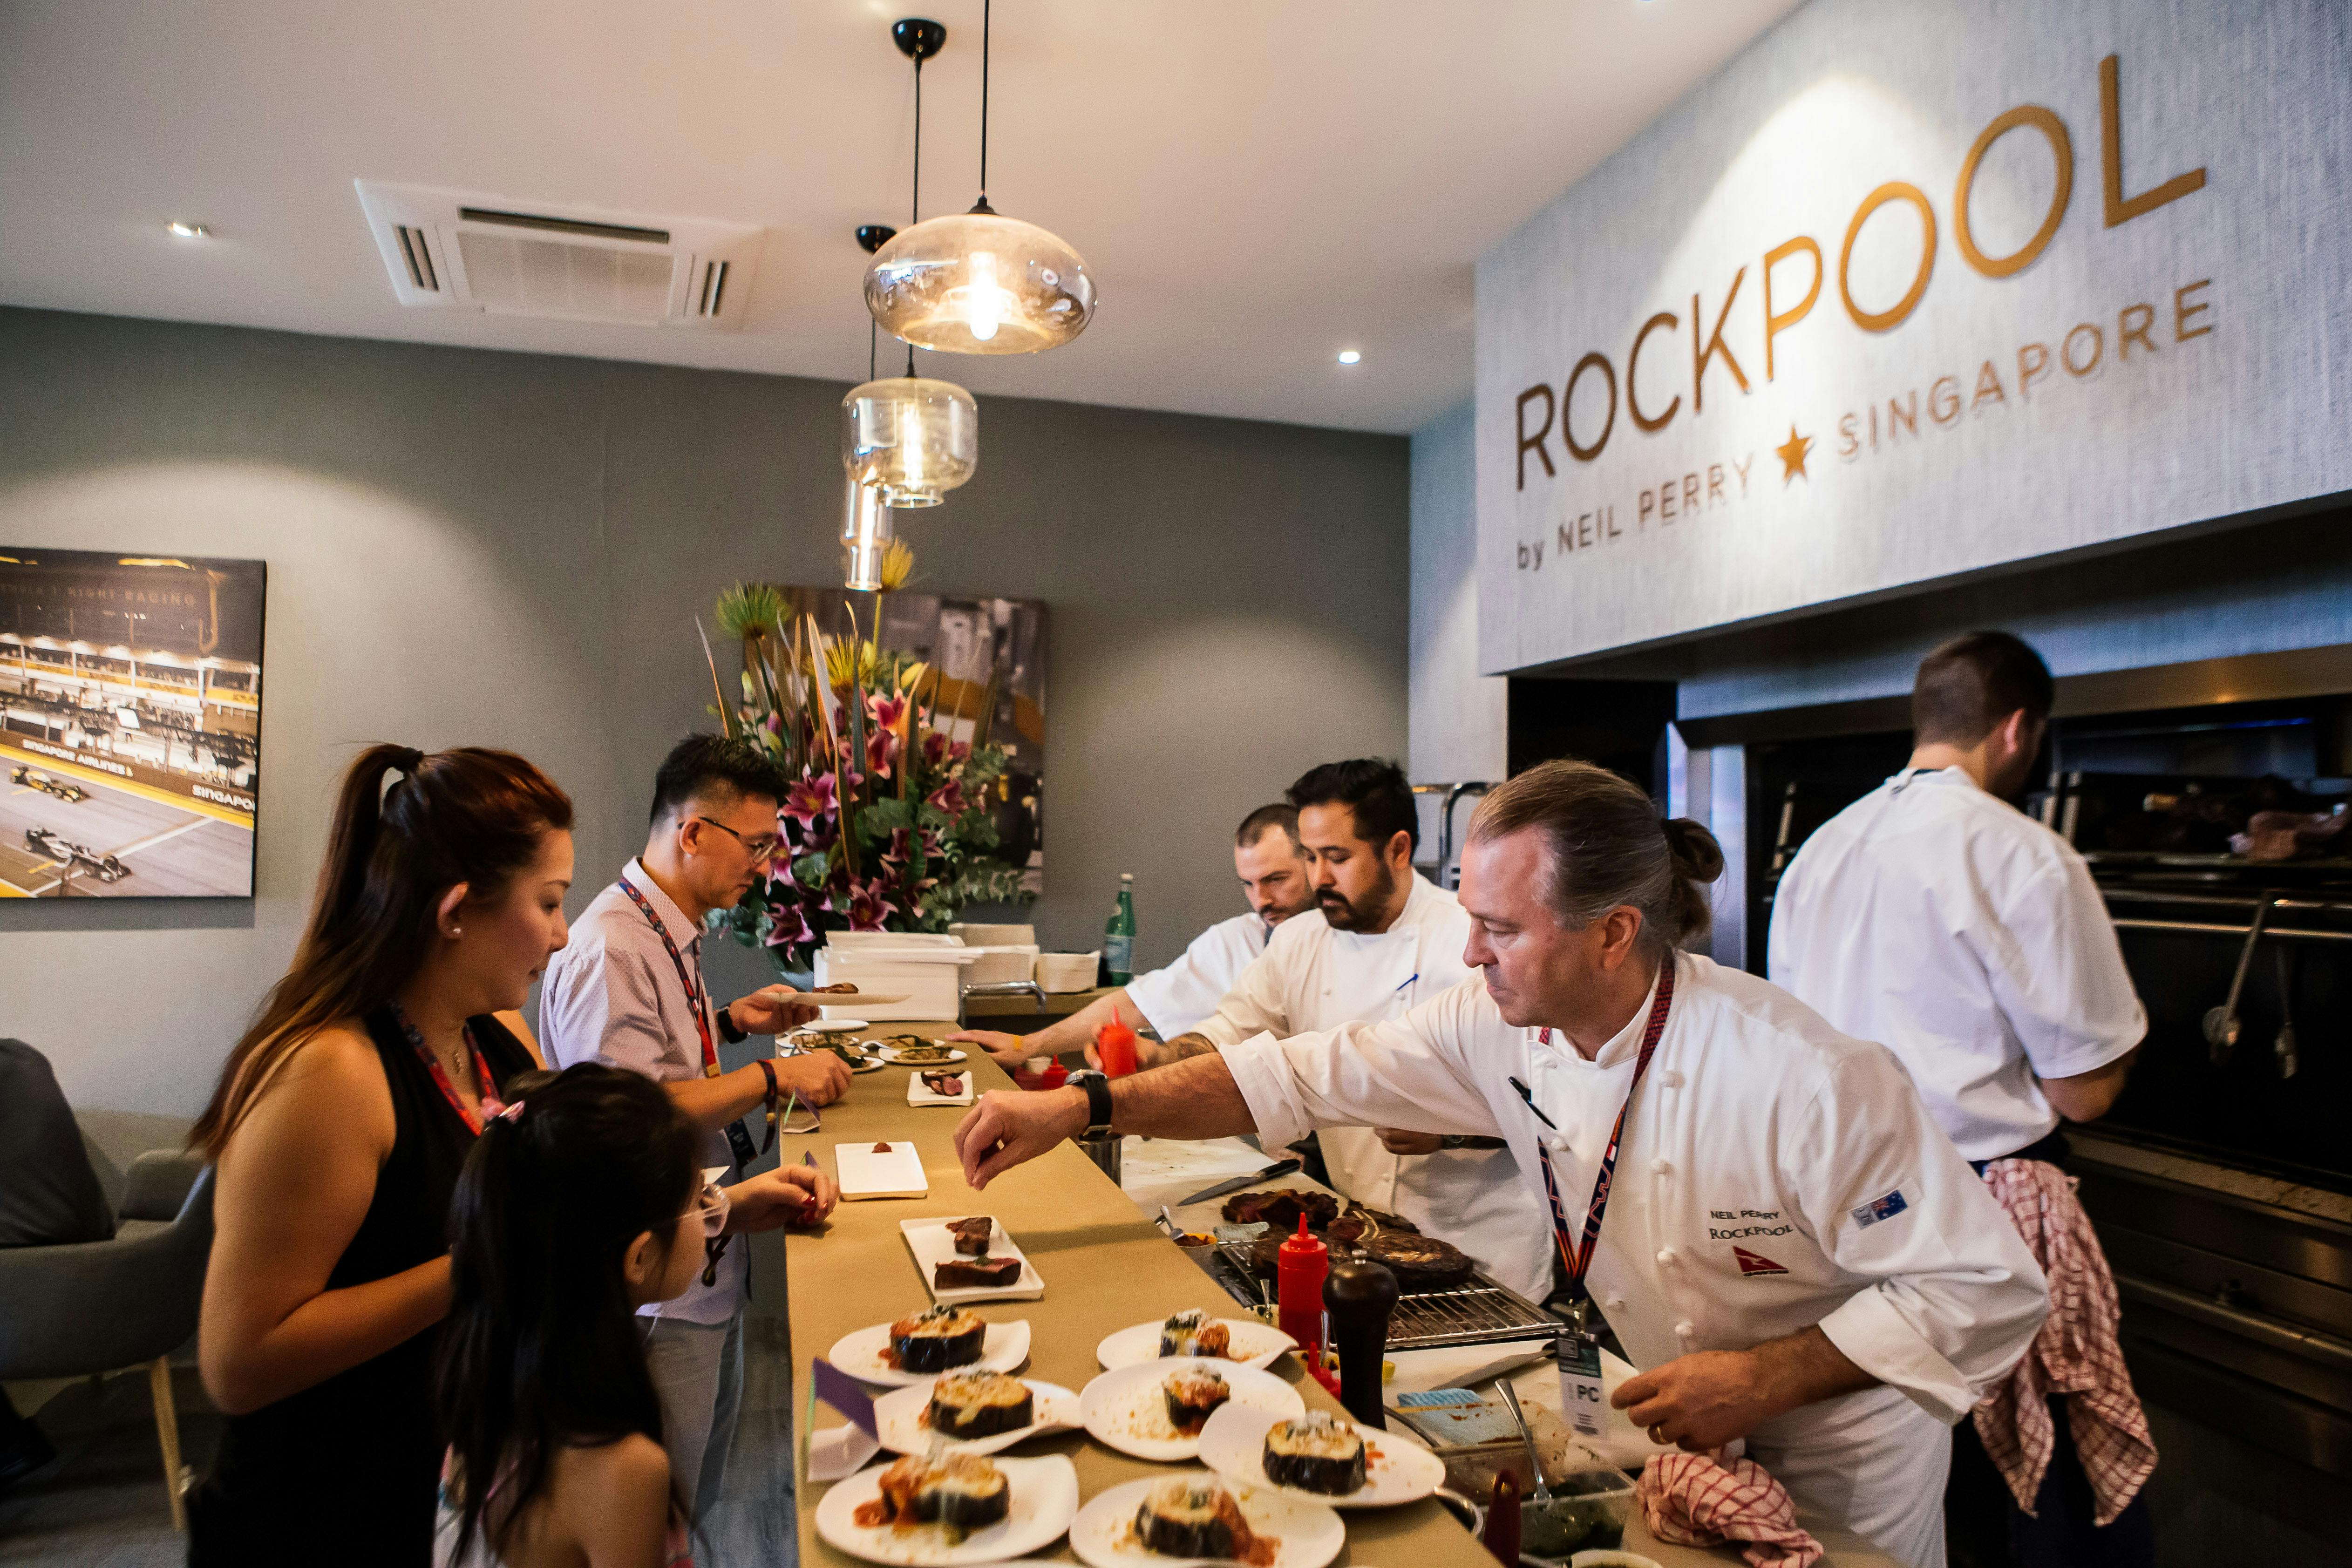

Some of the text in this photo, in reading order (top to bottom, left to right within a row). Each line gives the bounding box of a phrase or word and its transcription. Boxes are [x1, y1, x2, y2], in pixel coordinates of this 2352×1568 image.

[1516, 54, 2207, 491] ROCKPOOL
[1516, 279, 2212, 571] by NEIL PERRY SINGAPORE
[124, 589, 195, 605] RACING
[193, 784, 255, 811] SINGAPO
[1711, 1210, 1780, 1220] NEIL PERRY
[1709, 1225, 1793, 1239] ROCKPOOL
[1577, 1384, 1599, 1402] PC
